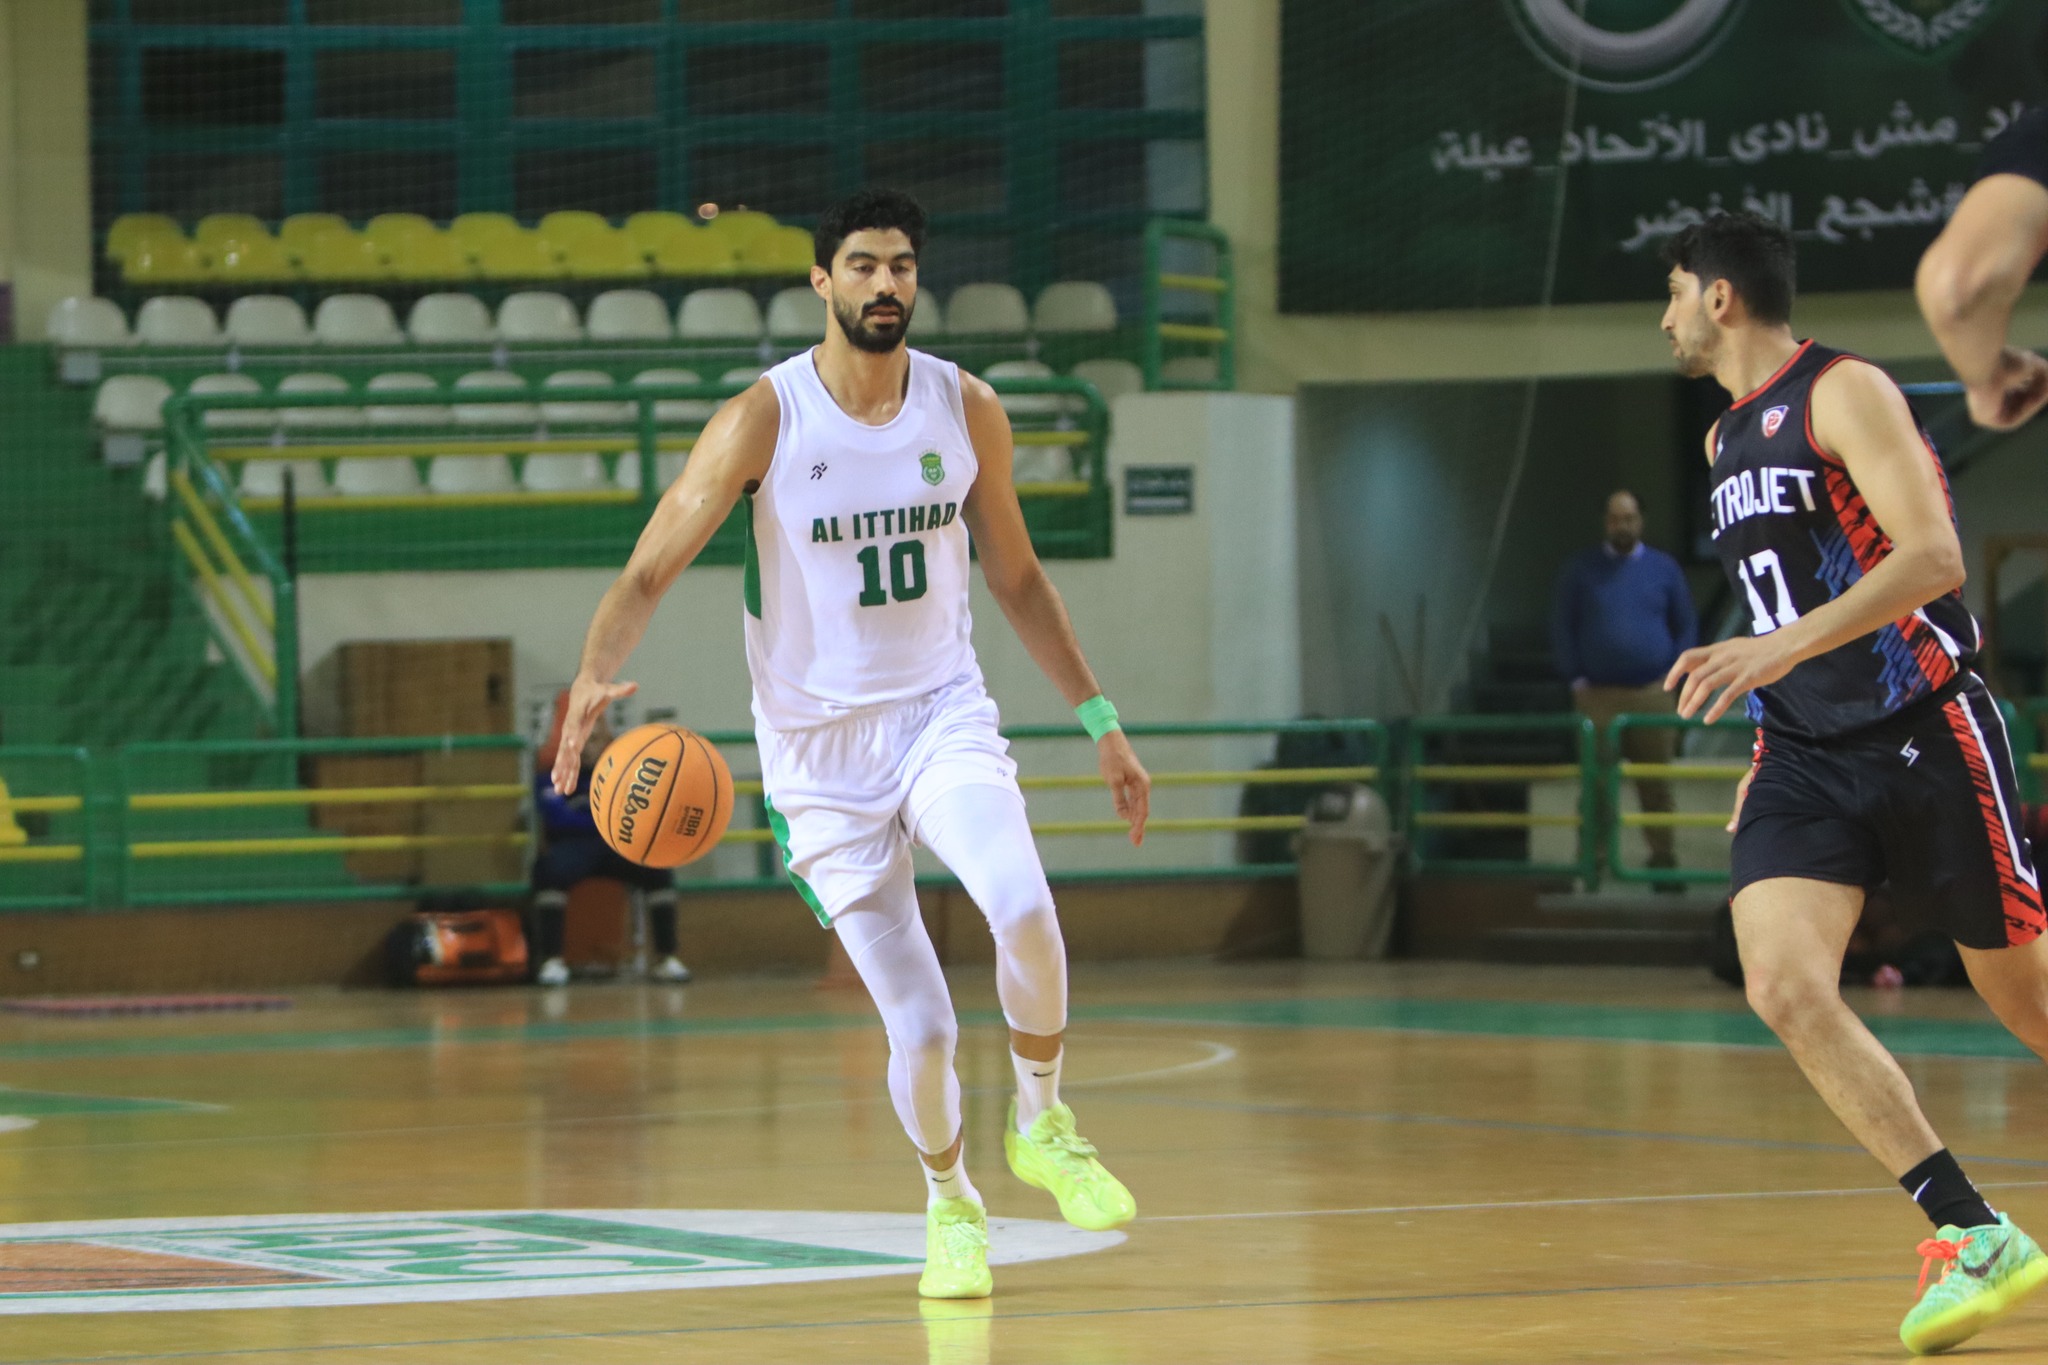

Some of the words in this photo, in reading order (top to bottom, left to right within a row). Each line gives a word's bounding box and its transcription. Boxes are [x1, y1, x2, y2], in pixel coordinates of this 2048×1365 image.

[812, 516, 843, 543] AL
[853, 502, 957, 540] ITTIHAD
[1711, 467, 1816, 540] TROJET
[856, 539, 927, 607] 10
[1738, 549, 1800, 635] 17
[618, 757, 668, 844] Wilson
[682, 806, 705, 837] FIBA
